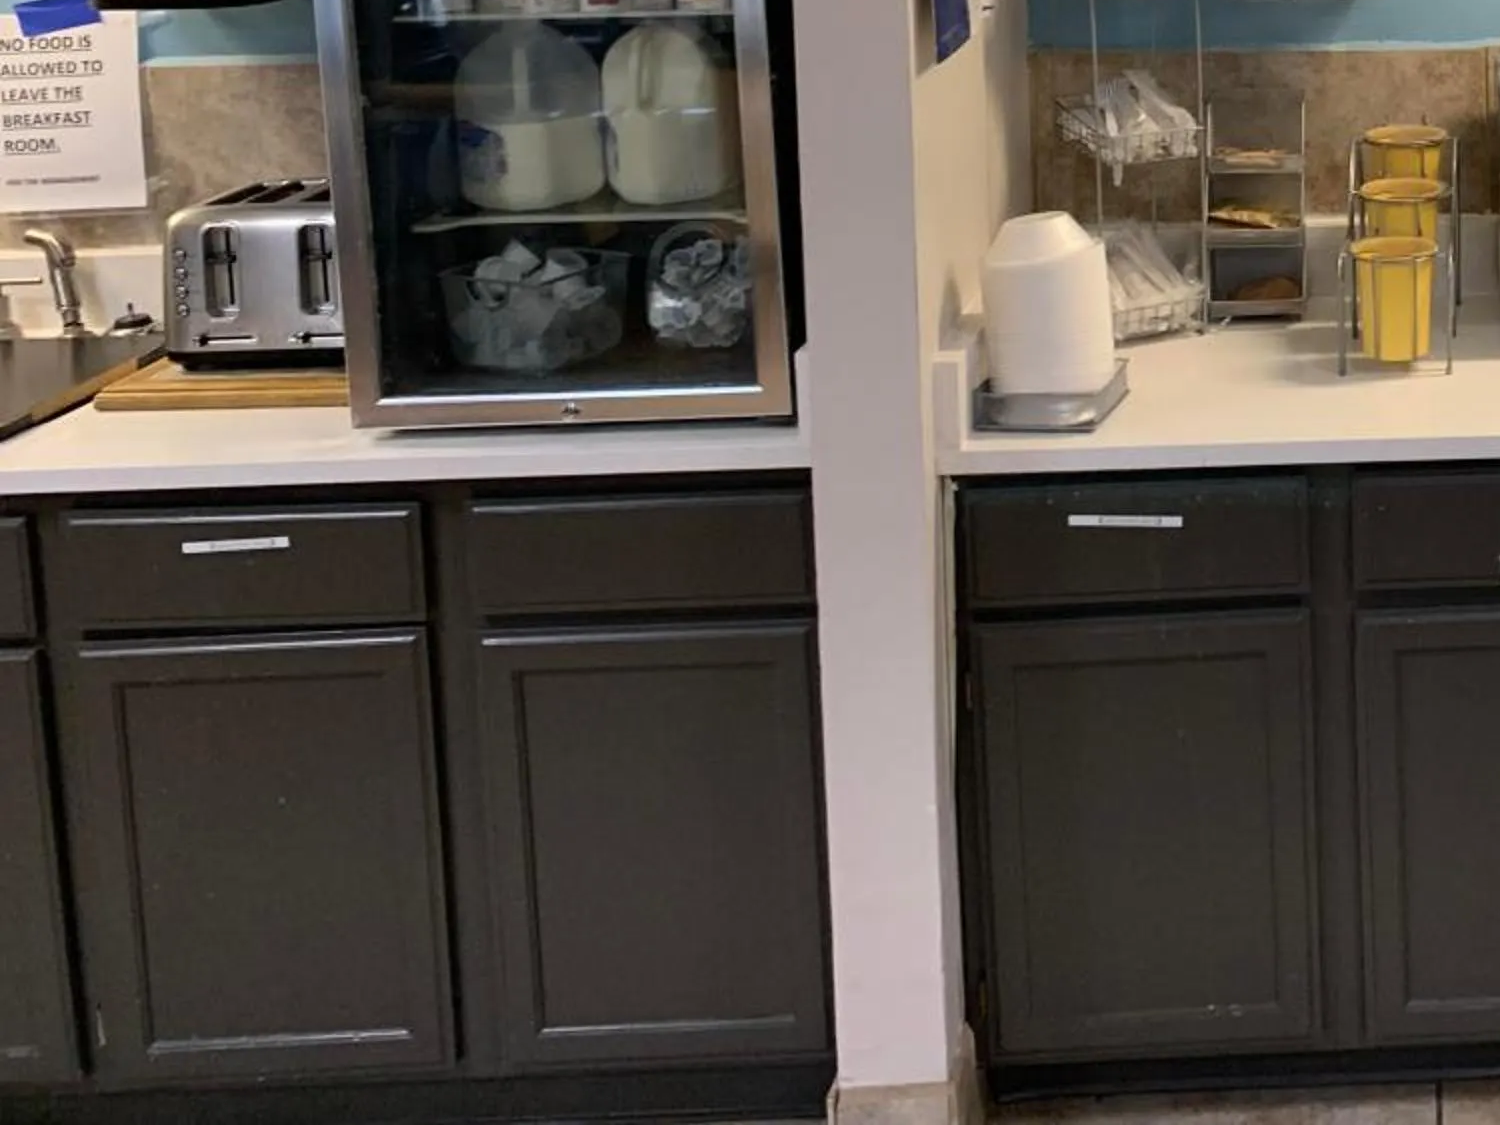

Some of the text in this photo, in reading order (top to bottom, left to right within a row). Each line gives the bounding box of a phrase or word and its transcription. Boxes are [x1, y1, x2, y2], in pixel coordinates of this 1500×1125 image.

[0, 35, 92, 53] NO FOOD IS
[1, 60, 103, 76] ALLOWED TO
[1, 86, 83, 102] LEAVE THE
[3, 111, 92, 127] BREAKFAST
[4, 138, 61, 153] ROOM.
